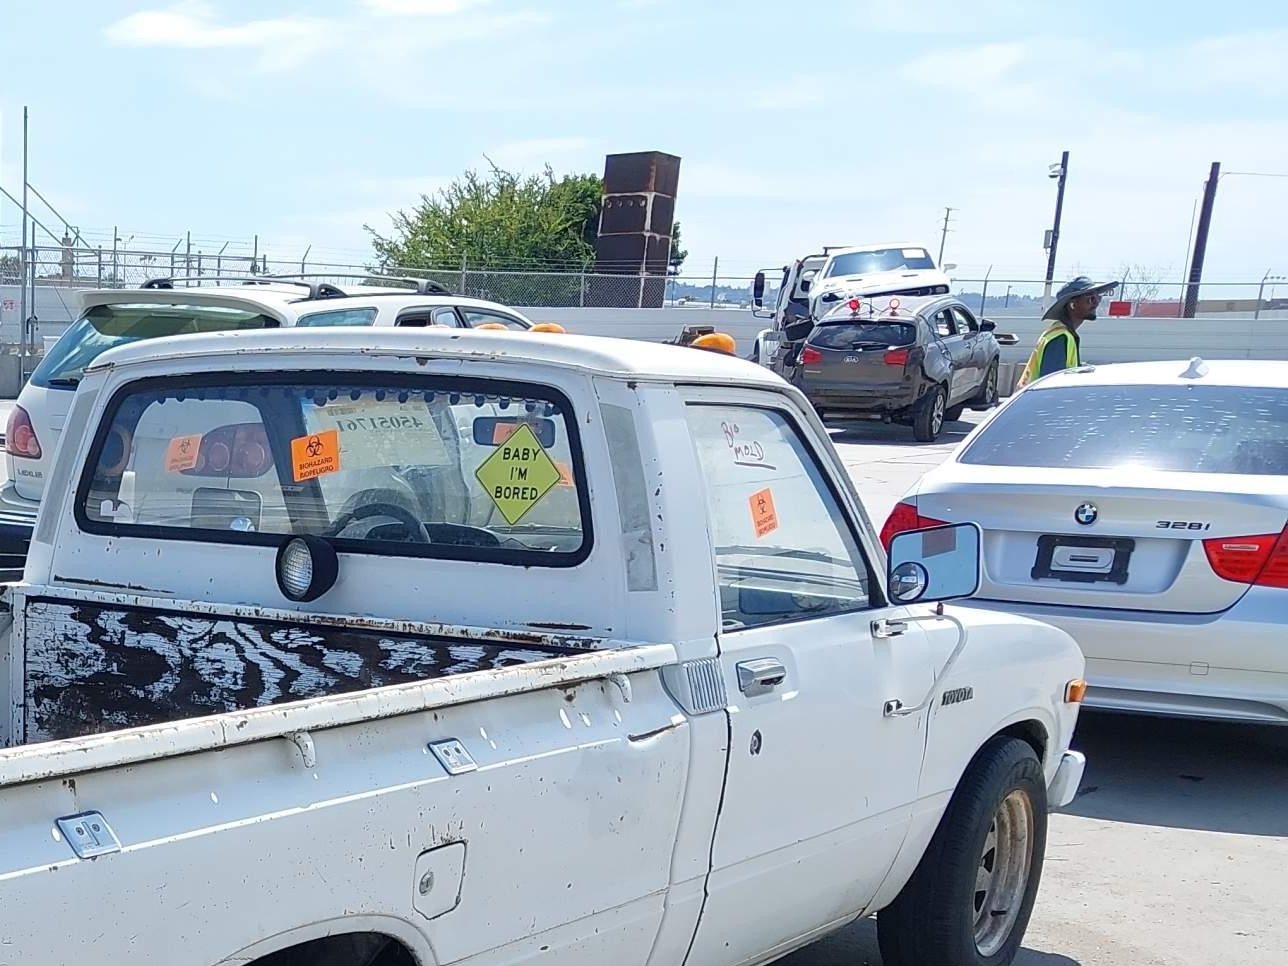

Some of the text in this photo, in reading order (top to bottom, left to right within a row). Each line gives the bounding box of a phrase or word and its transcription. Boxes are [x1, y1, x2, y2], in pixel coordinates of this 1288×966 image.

[502, 447, 540, 461] BABY
[299, 456, 333, 470] BIOHAZARD
[510, 466, 528, 480] I'M
[494, 485, 538, 500] BORED
[941, 687, 973, 706] TOYOTA
